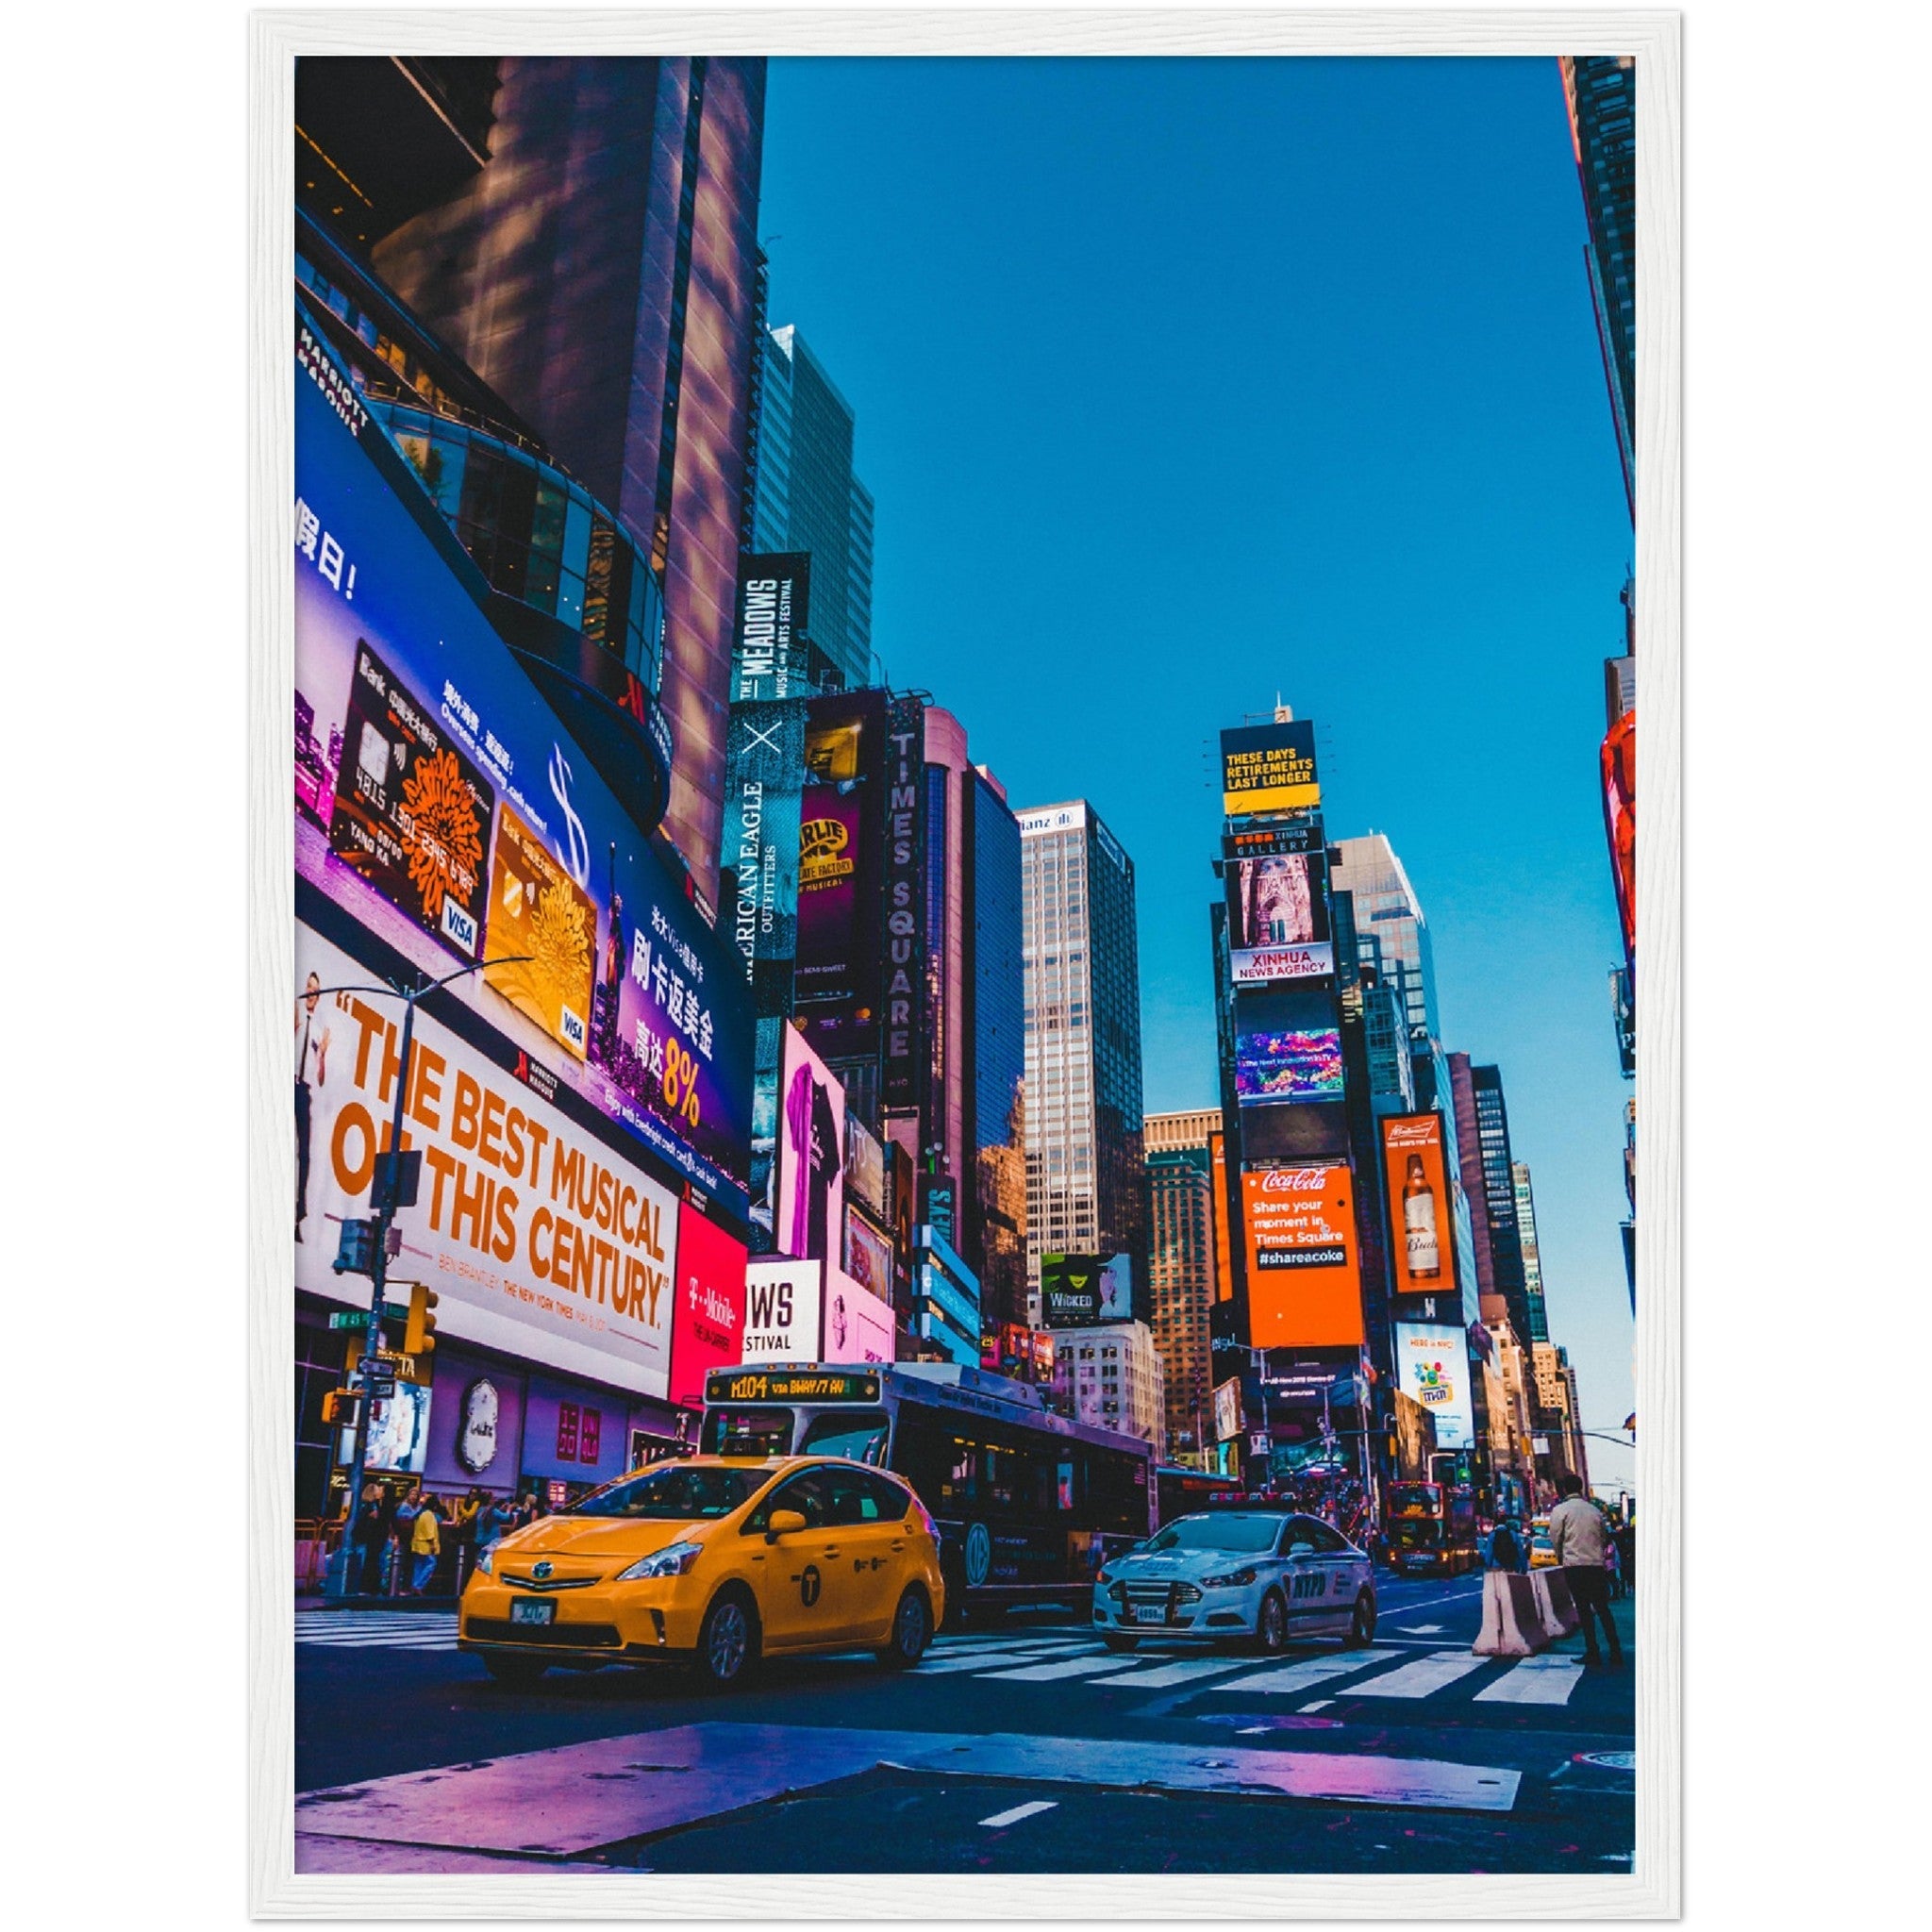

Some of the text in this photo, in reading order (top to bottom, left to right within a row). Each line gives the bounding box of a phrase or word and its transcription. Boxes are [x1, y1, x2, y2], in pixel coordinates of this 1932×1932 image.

[300, 328, 369, 427] MARRIOTT
[779, 577, 793, 622] FESTIVAL
[741, 578, 778, 676] MEADOWS
[777, 625, 791, 649] ARTS
[741, 679, 753, 699] THE
[775, 666, 789, 699] MUSIC
[1226, 747, 1296, 766] THESE DAYS
[1226, 758, 1313, 778] RETIREMENTS
[1227, 771, 1310, 791] LAST LONGER
[740, 781, 763, 859] EAGLE
[800, 820, 843, 850] RLIE
[1274, 829, 1308, 841] XINHUA
[1237, 840, 1308, 856] GALLERY
[818, 860, 851, 874] FACTORY
[761, 845, 776, 933] OUTFITTERS
[806, 878, 843, 891] MUSICAL
[889, 732, 916, 1057] TIMES SQUARE
[447, 905, 473, 945] VISA
[1240, 961, 1325, 979] NEWS AGENCY
[1252, 950, 1311, 967] XINHUA
[563, 1012, 583, 1044] VISA
[663, 1037, 700, 1127] 8%
[451, 1069, 549, 1190] BEST
[551, 1137, 666, 1263] MUSICAL
[1261, 1168, 1327, 1193] Coca-Cola
[425, 1144, 520, 1264] THIS
[1252, 1199, 1323, 1217] Share your
[1254, 1216, 1323, 1229] moment in
[1255, 1228, 1343, 1245] Times Square
[1258, 1251, 1343, 1265] #shareacoke
[503, 1279, 518, 1298] THE
[518, 1287, 535, 1306] NEW
[536, 1293, 554, 1310] YORK
[556, 1300, 574, 1320] TIMES
[744, 1282, 794, 1329] WS
[731, 1376, 768, 1398] M104
[790, 1379, 828, 1394] BWAY/7
[829, 1379, 844, 1393] AV
[1293, 1573, 1325, 1598] NYPD
